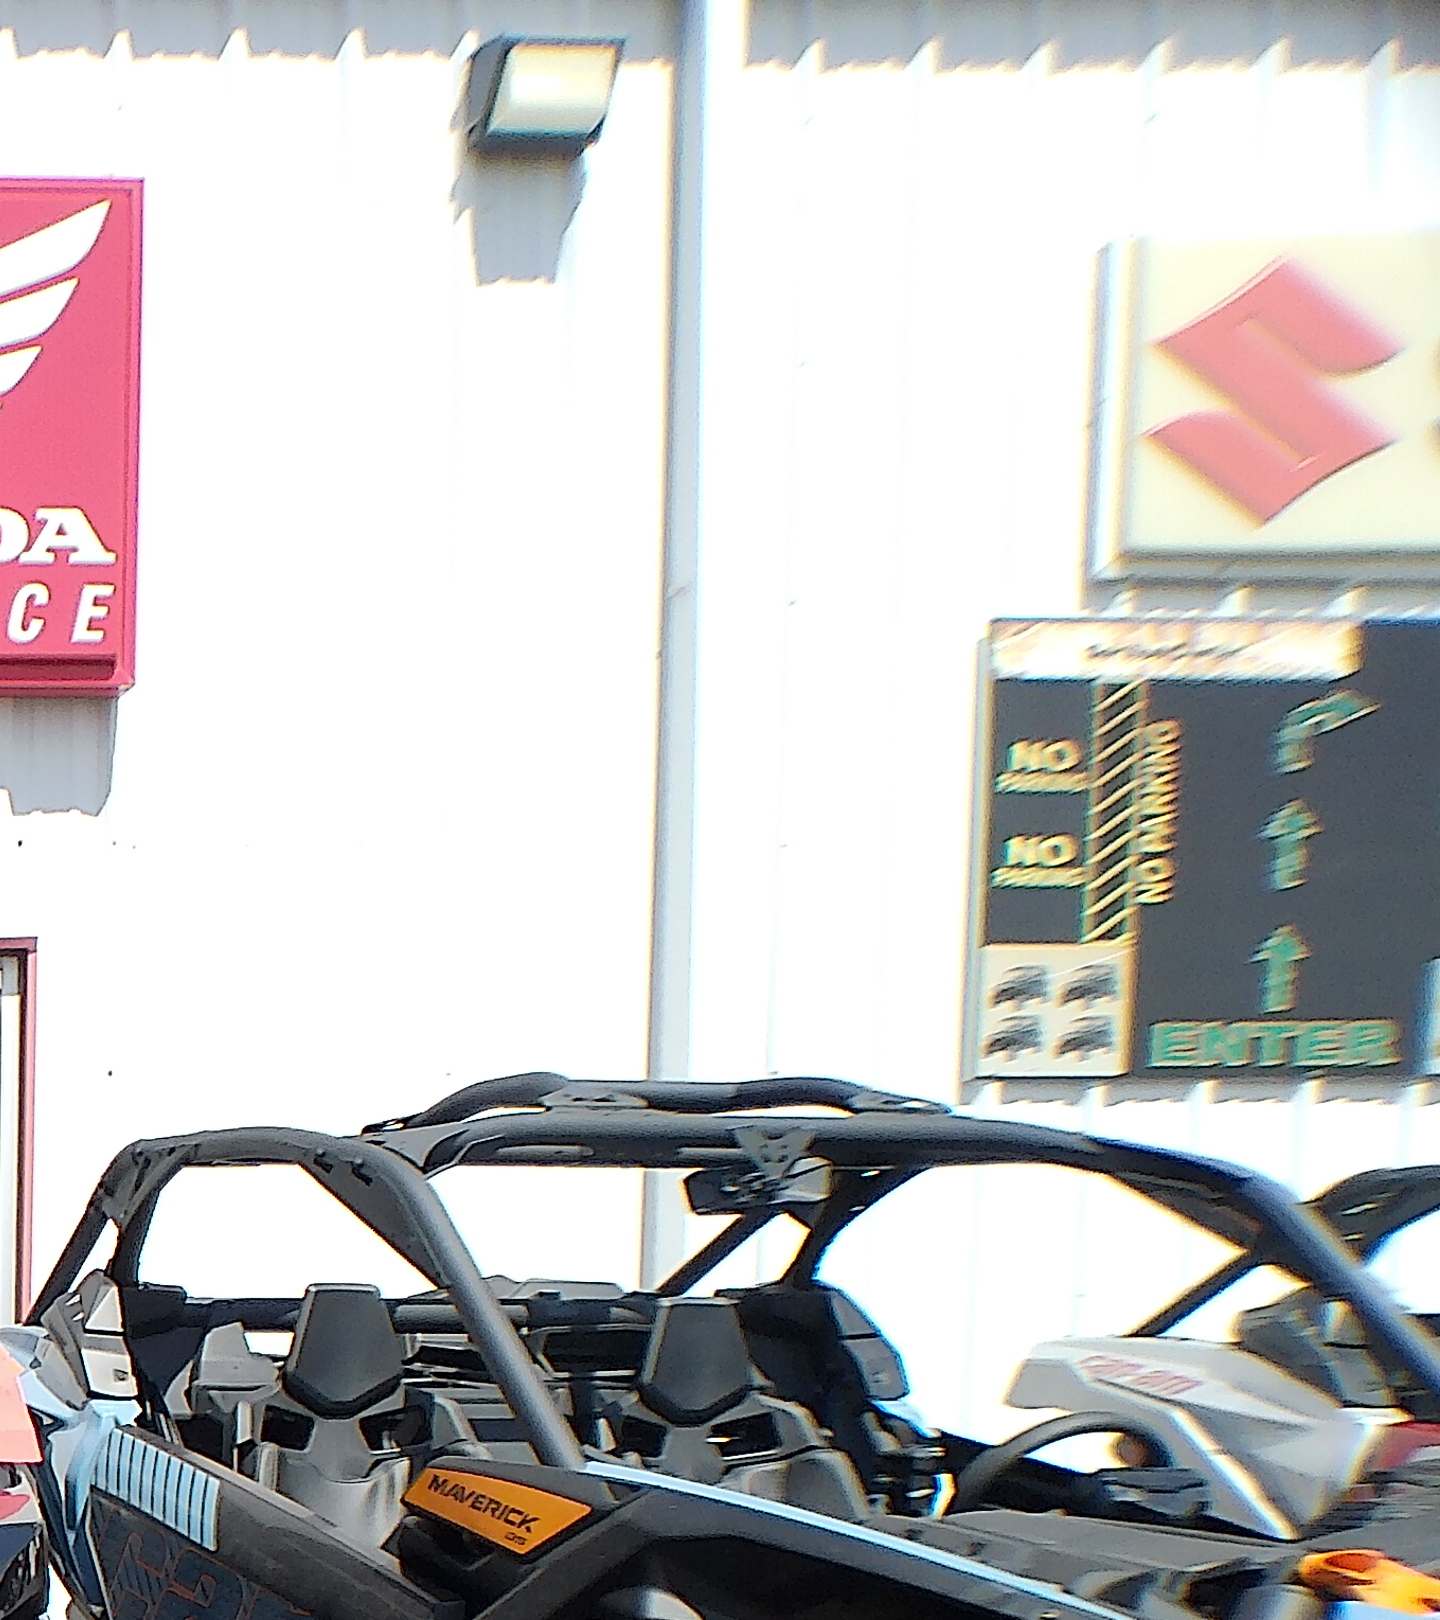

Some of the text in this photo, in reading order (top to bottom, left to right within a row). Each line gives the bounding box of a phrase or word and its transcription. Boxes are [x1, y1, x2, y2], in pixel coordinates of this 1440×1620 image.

[1008, 739, 1082, 772] NO
[1004, 833, 1078, 867] NO
[1135, 855, 1178, 905] NO
[1148, 1019, 1401, 1067] ENTER
[427, 1474, 540, 1533] MAVERICK
